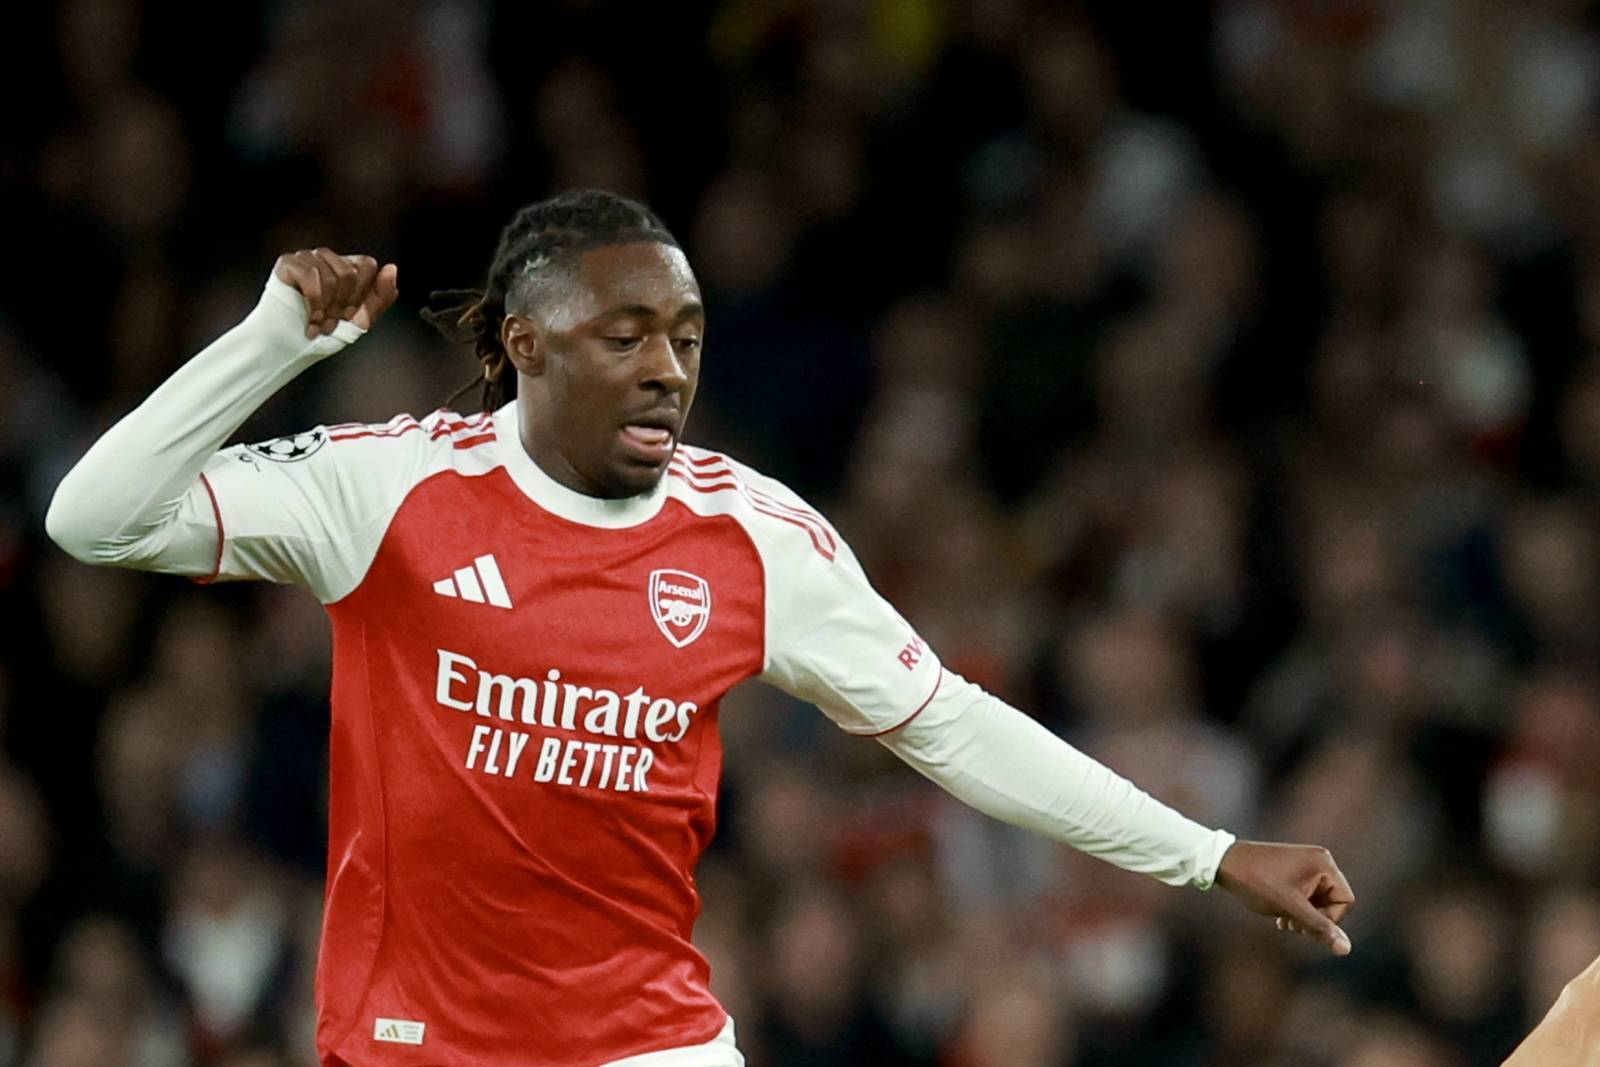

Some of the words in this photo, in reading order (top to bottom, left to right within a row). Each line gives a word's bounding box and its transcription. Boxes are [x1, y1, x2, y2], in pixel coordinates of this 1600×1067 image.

[658, 580, 703, 601] Arsenal
[436, 648, 698, 743] Emirates
[465, 724, 530, 778] FLY
[533, 737, 655, 792] BETTER
